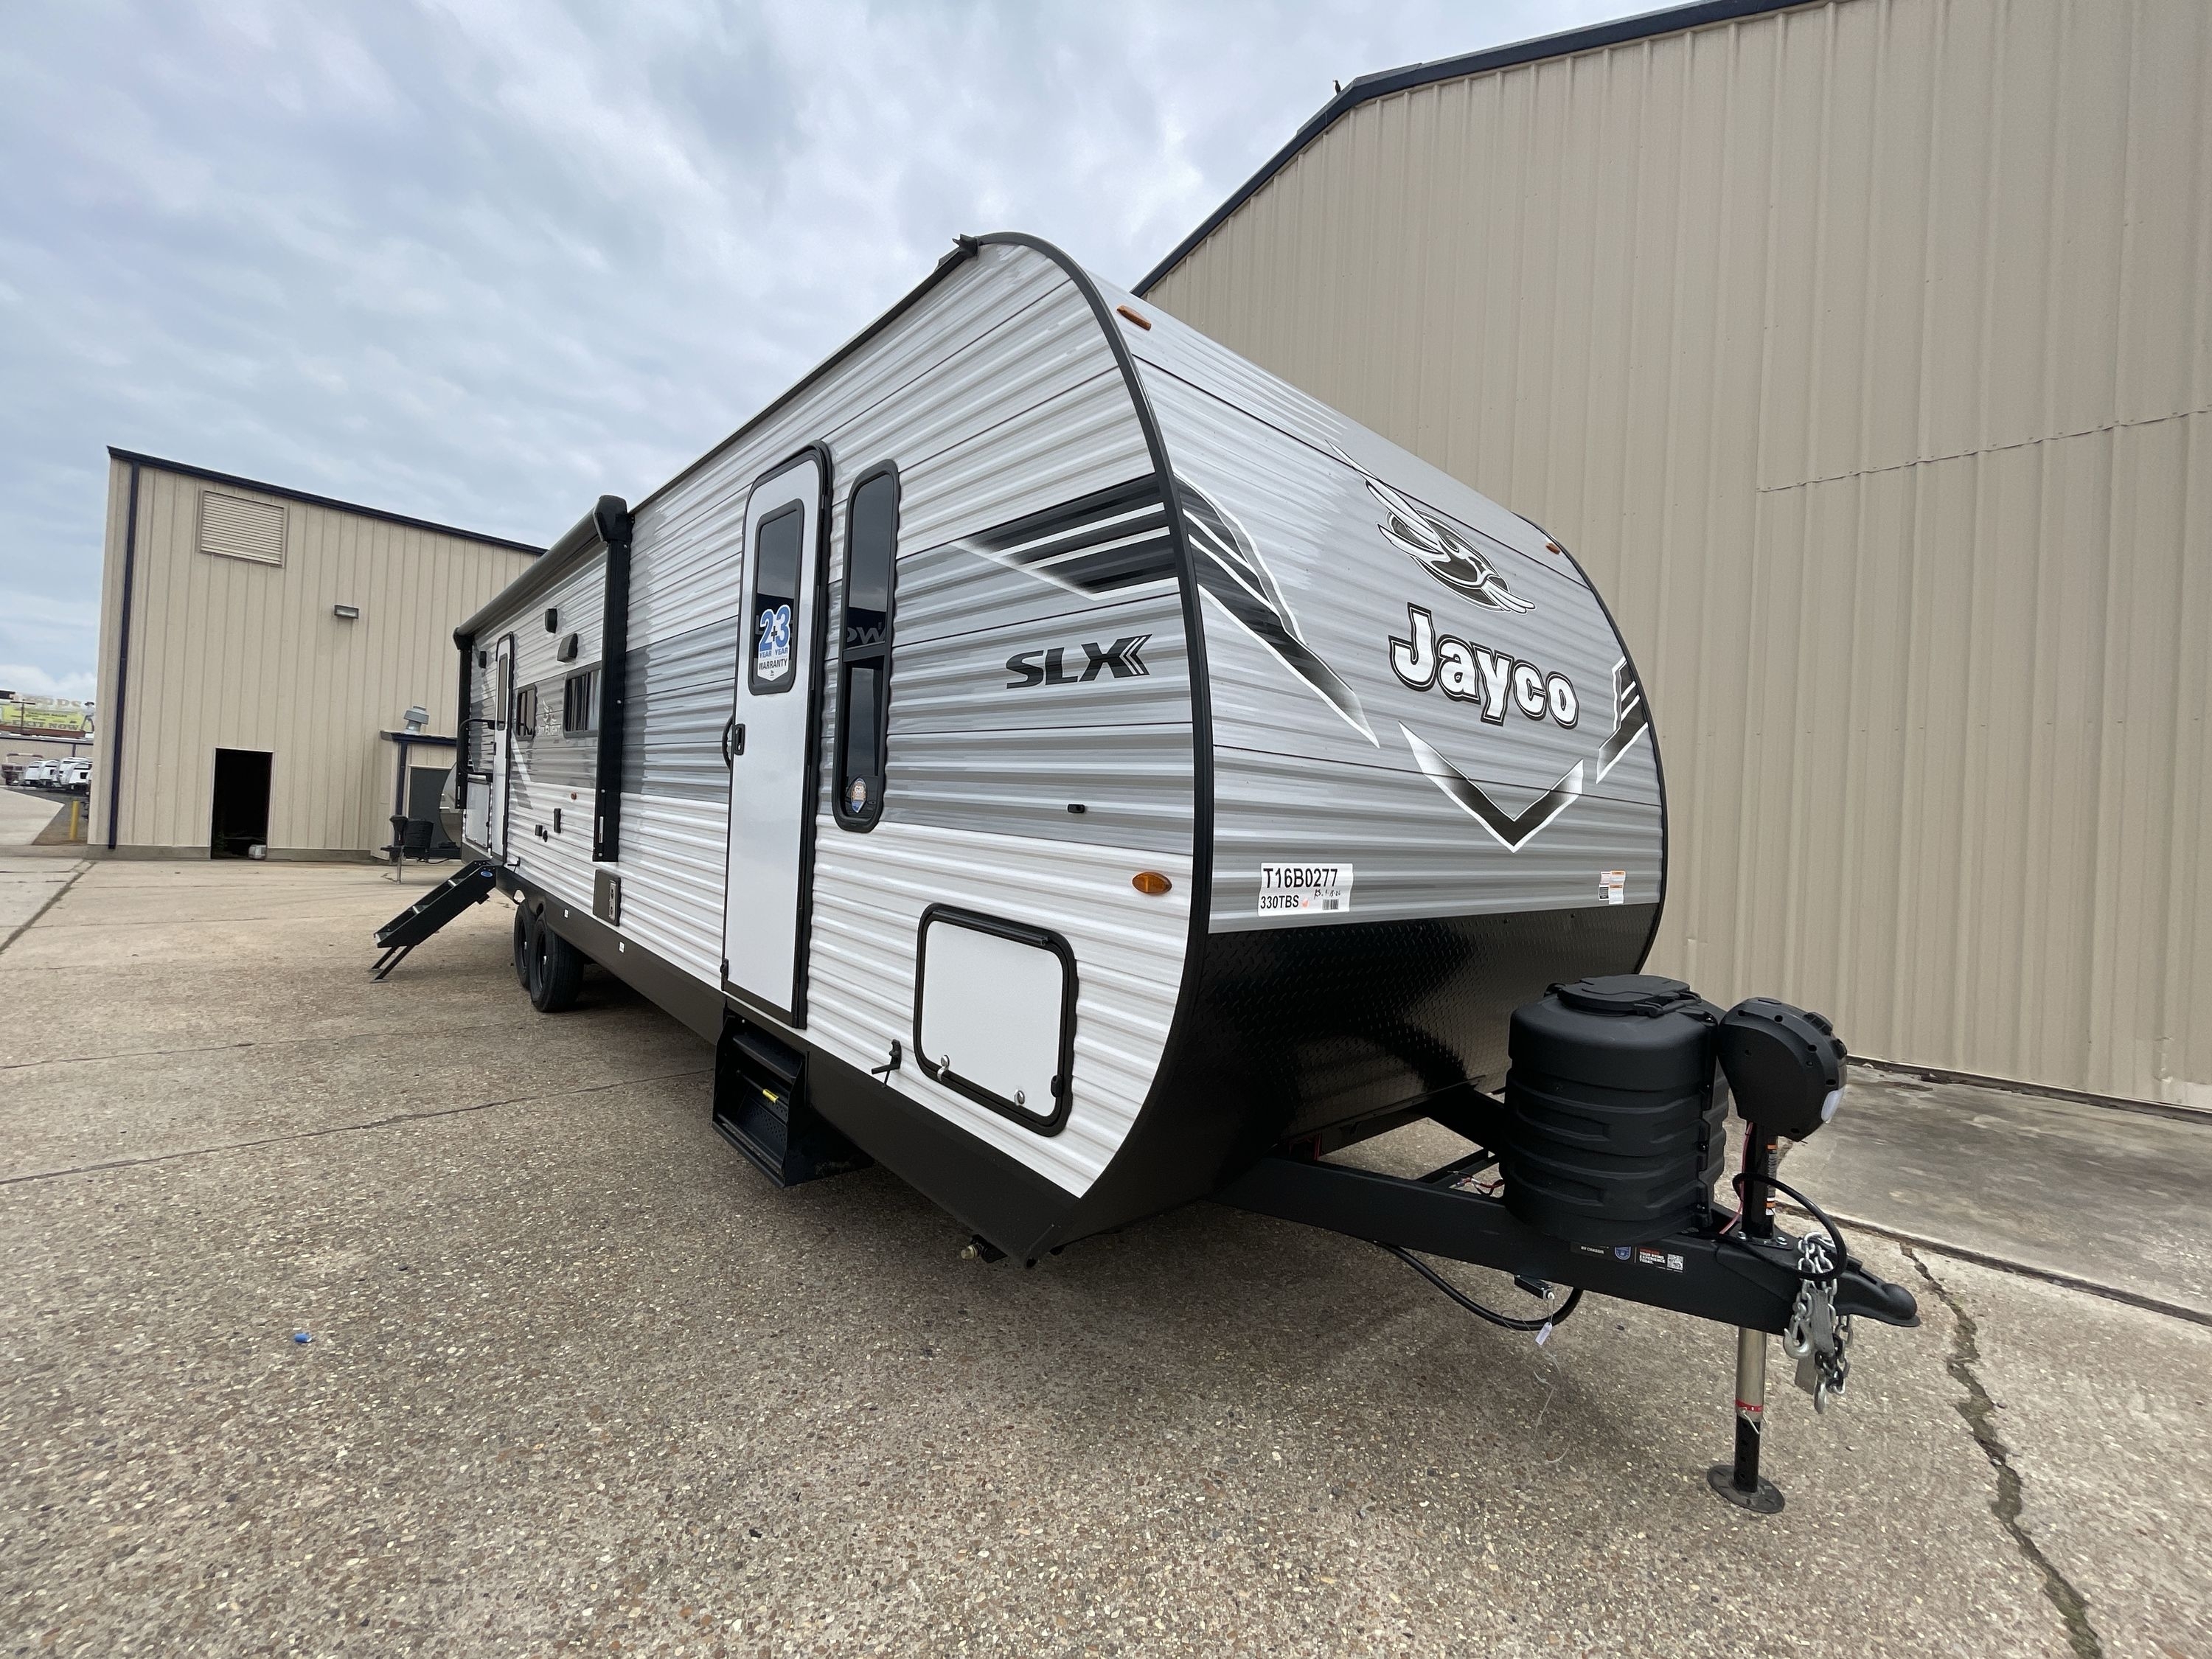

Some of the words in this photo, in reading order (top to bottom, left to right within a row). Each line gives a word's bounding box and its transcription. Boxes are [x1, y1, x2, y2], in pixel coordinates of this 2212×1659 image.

[759, 650, 772, 658] YEAR
[775, 647, 788, 655] YEAR
[1006, 633, 1152, 689] SLX
[759, 658, 787, 670] WARRANTY
[1388, 602, 1579, 729] Jayco
[1263, 868, 1338, 888] T16B0277
[1260, 895, 1299, 909] 330TBS
